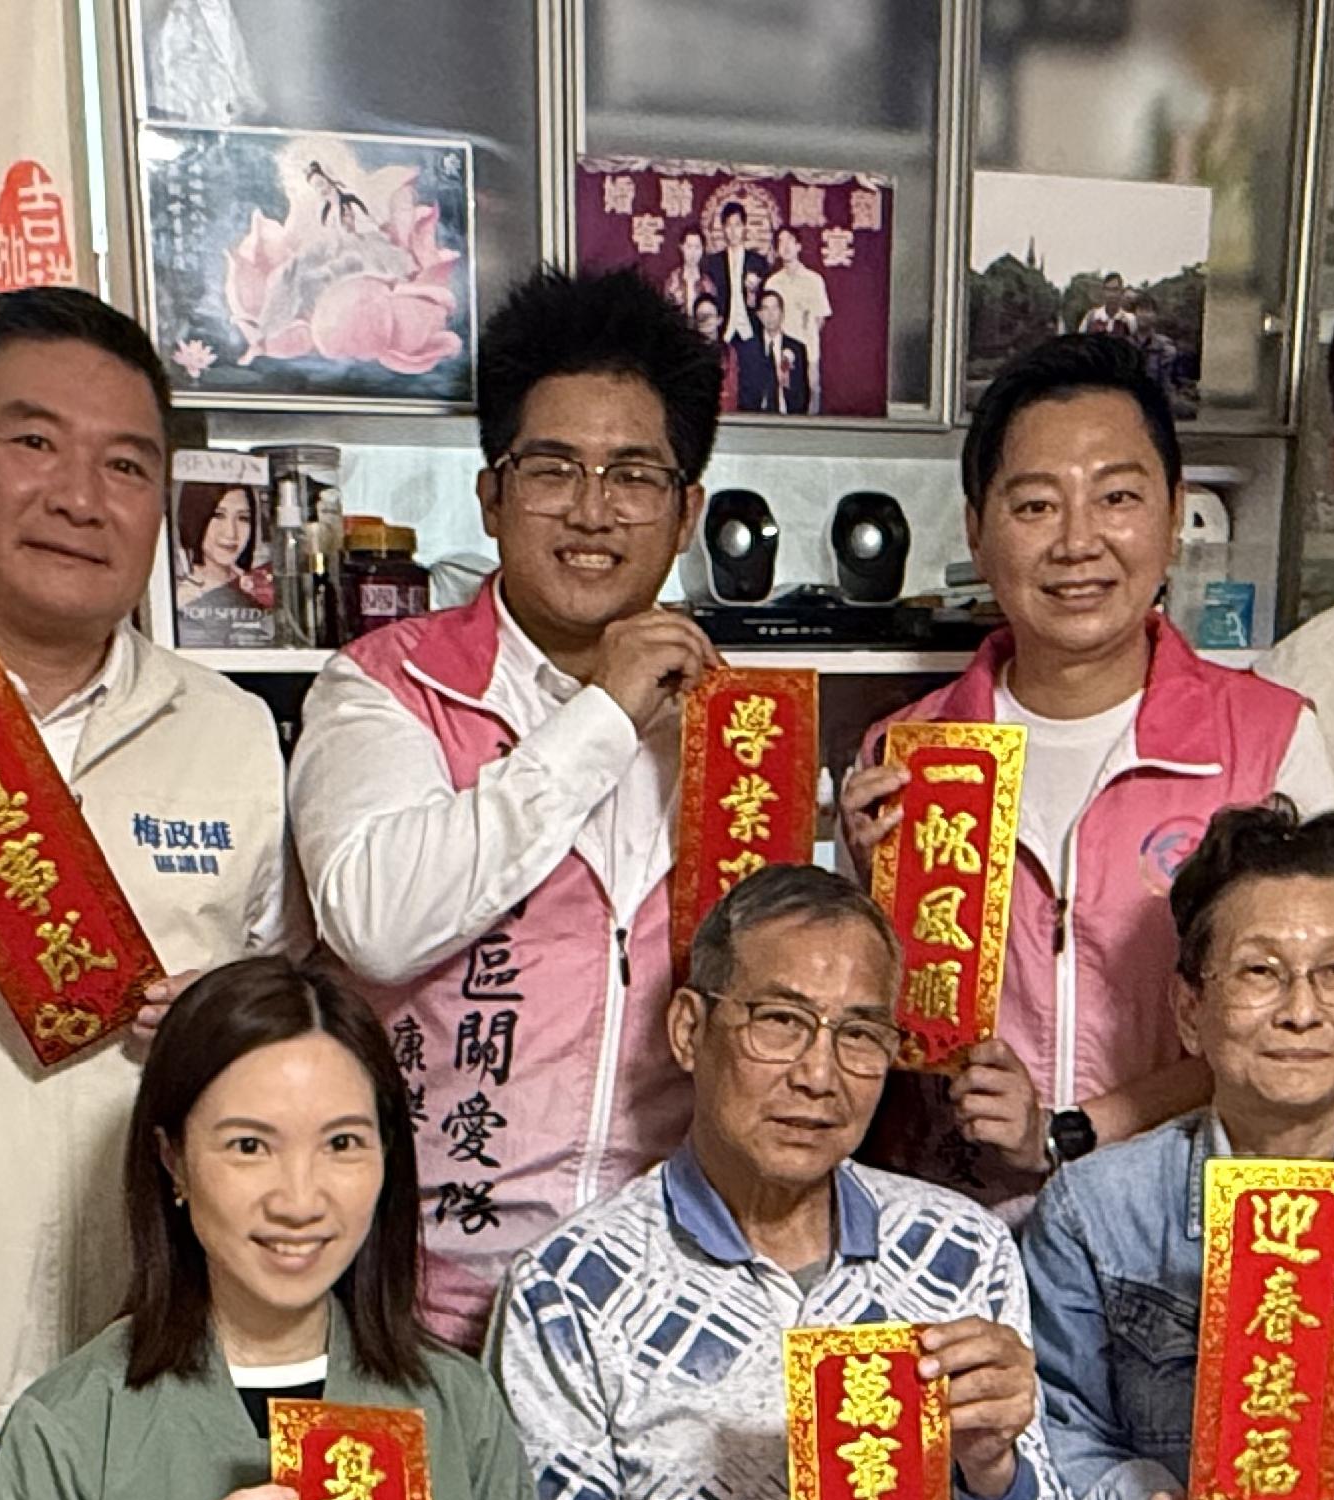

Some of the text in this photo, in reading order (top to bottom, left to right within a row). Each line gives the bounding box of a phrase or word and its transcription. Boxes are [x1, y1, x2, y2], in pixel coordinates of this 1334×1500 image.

[906, 763, 986, 1027] 一帆風順
[433, 898, 525, 1237] 區關愛隊
[1233, 1190, 1322, 1500] 迎春接福
